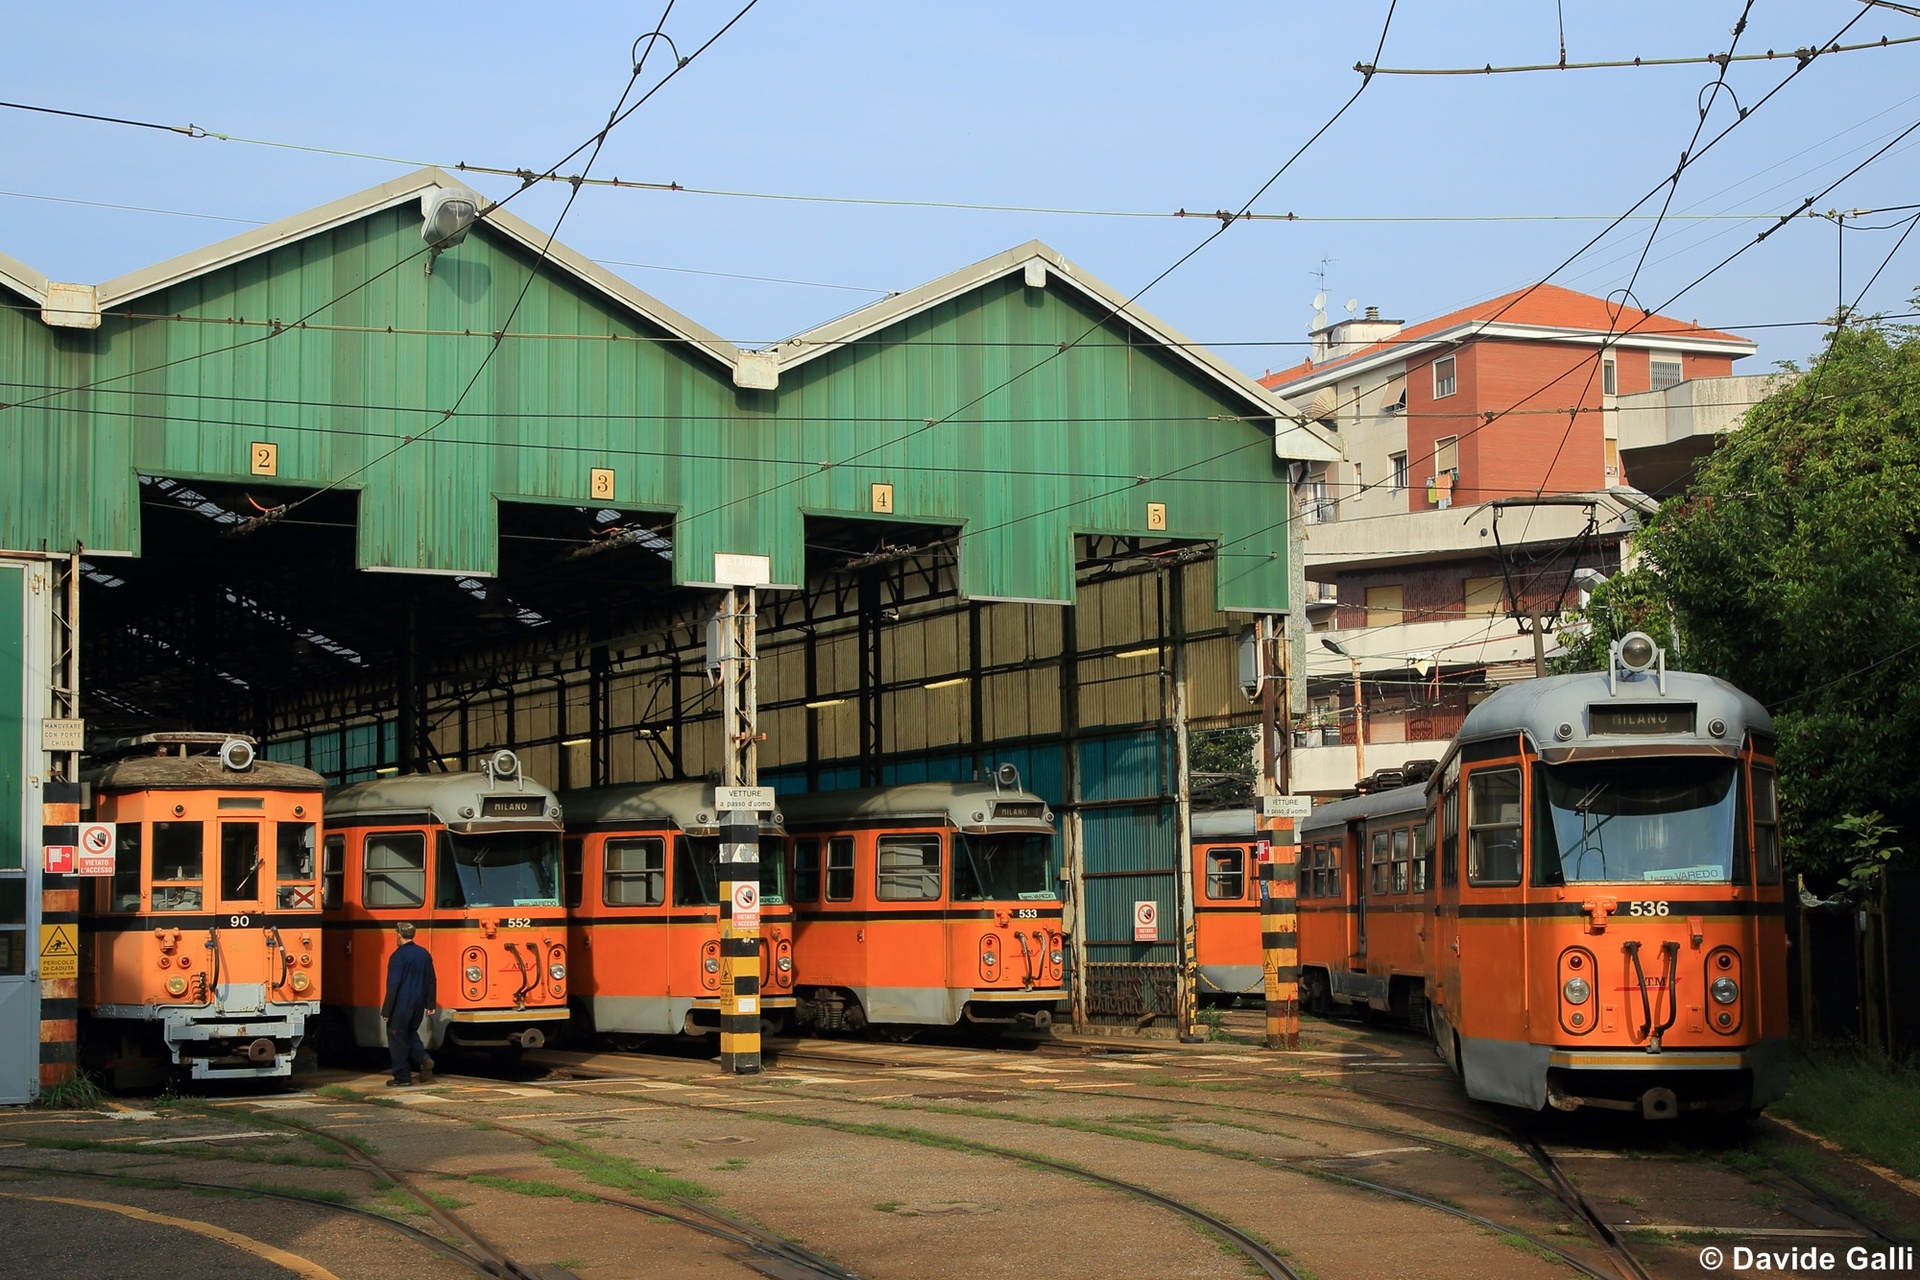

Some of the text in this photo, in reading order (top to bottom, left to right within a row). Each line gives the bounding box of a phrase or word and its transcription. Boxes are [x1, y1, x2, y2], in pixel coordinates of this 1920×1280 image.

[258, 449, 270, 467] 2
[597, 474, 608, 493] 3
[877, 491, 888, 508] 4
[1152, 508, 1161, 524] 5
[1612, 712, 1668, 725] MILANO
[494, 803, 528, 811] MILANO
[1001, 808, 1028, 816] MILANO
[80, 866, 113, 874] L'ACCESSO
[1675, 869, 1719, 880] VAREDO
[1019, 909, 1038, 918] 533
[1629, 901, 1670, 917] 536
[230, 915, 250, 927] 90
[507, 918, 531, 928] 552
